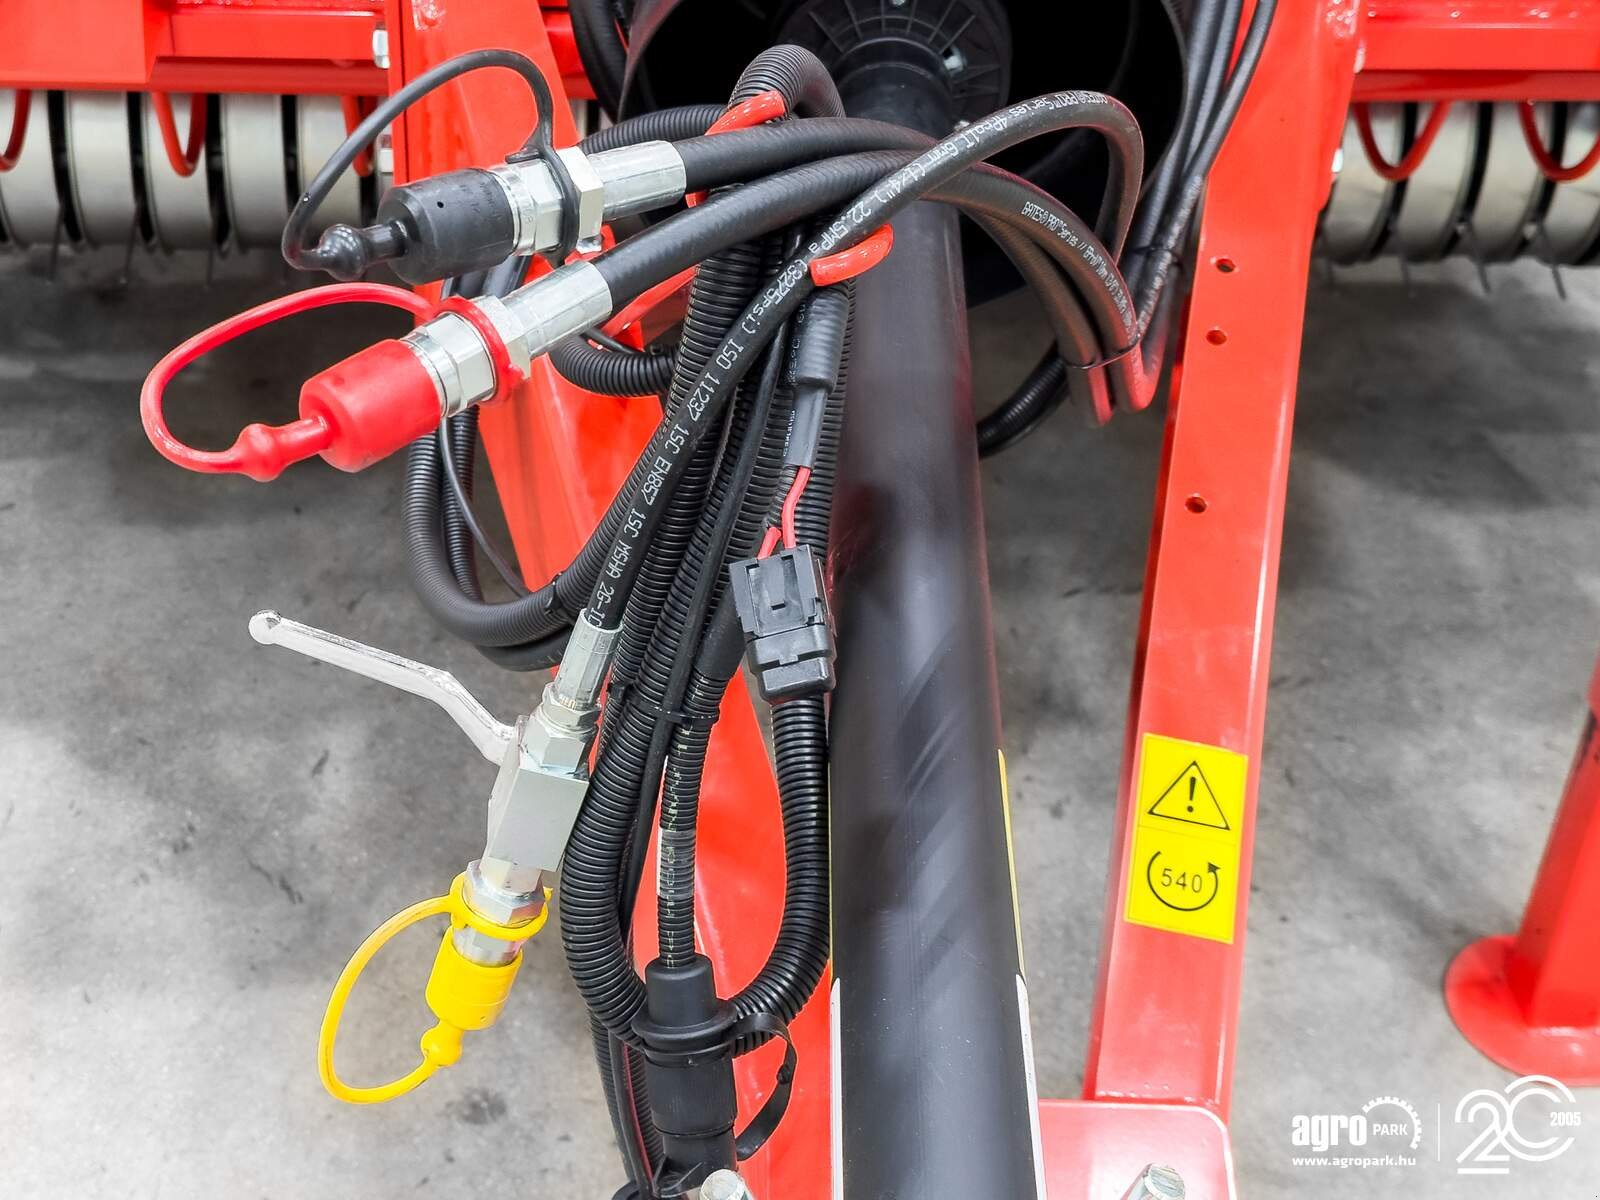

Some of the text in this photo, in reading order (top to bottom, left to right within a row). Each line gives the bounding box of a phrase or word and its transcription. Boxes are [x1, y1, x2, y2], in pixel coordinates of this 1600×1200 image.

[1008, 97, 1055, 117] Series
[808, 201, 872, 254] 22.5MPa
[716, 339, 744, 370] ISO
[687, 372, 720, 422] 11237
[665, 423, 689, 454] 1SC
[641, 456, 673, 506] EN857
[623, 508, 647, 538] 1SC
[606, 539, 632, 579] MSHA
[1161, 868, 1203, 893] 540
